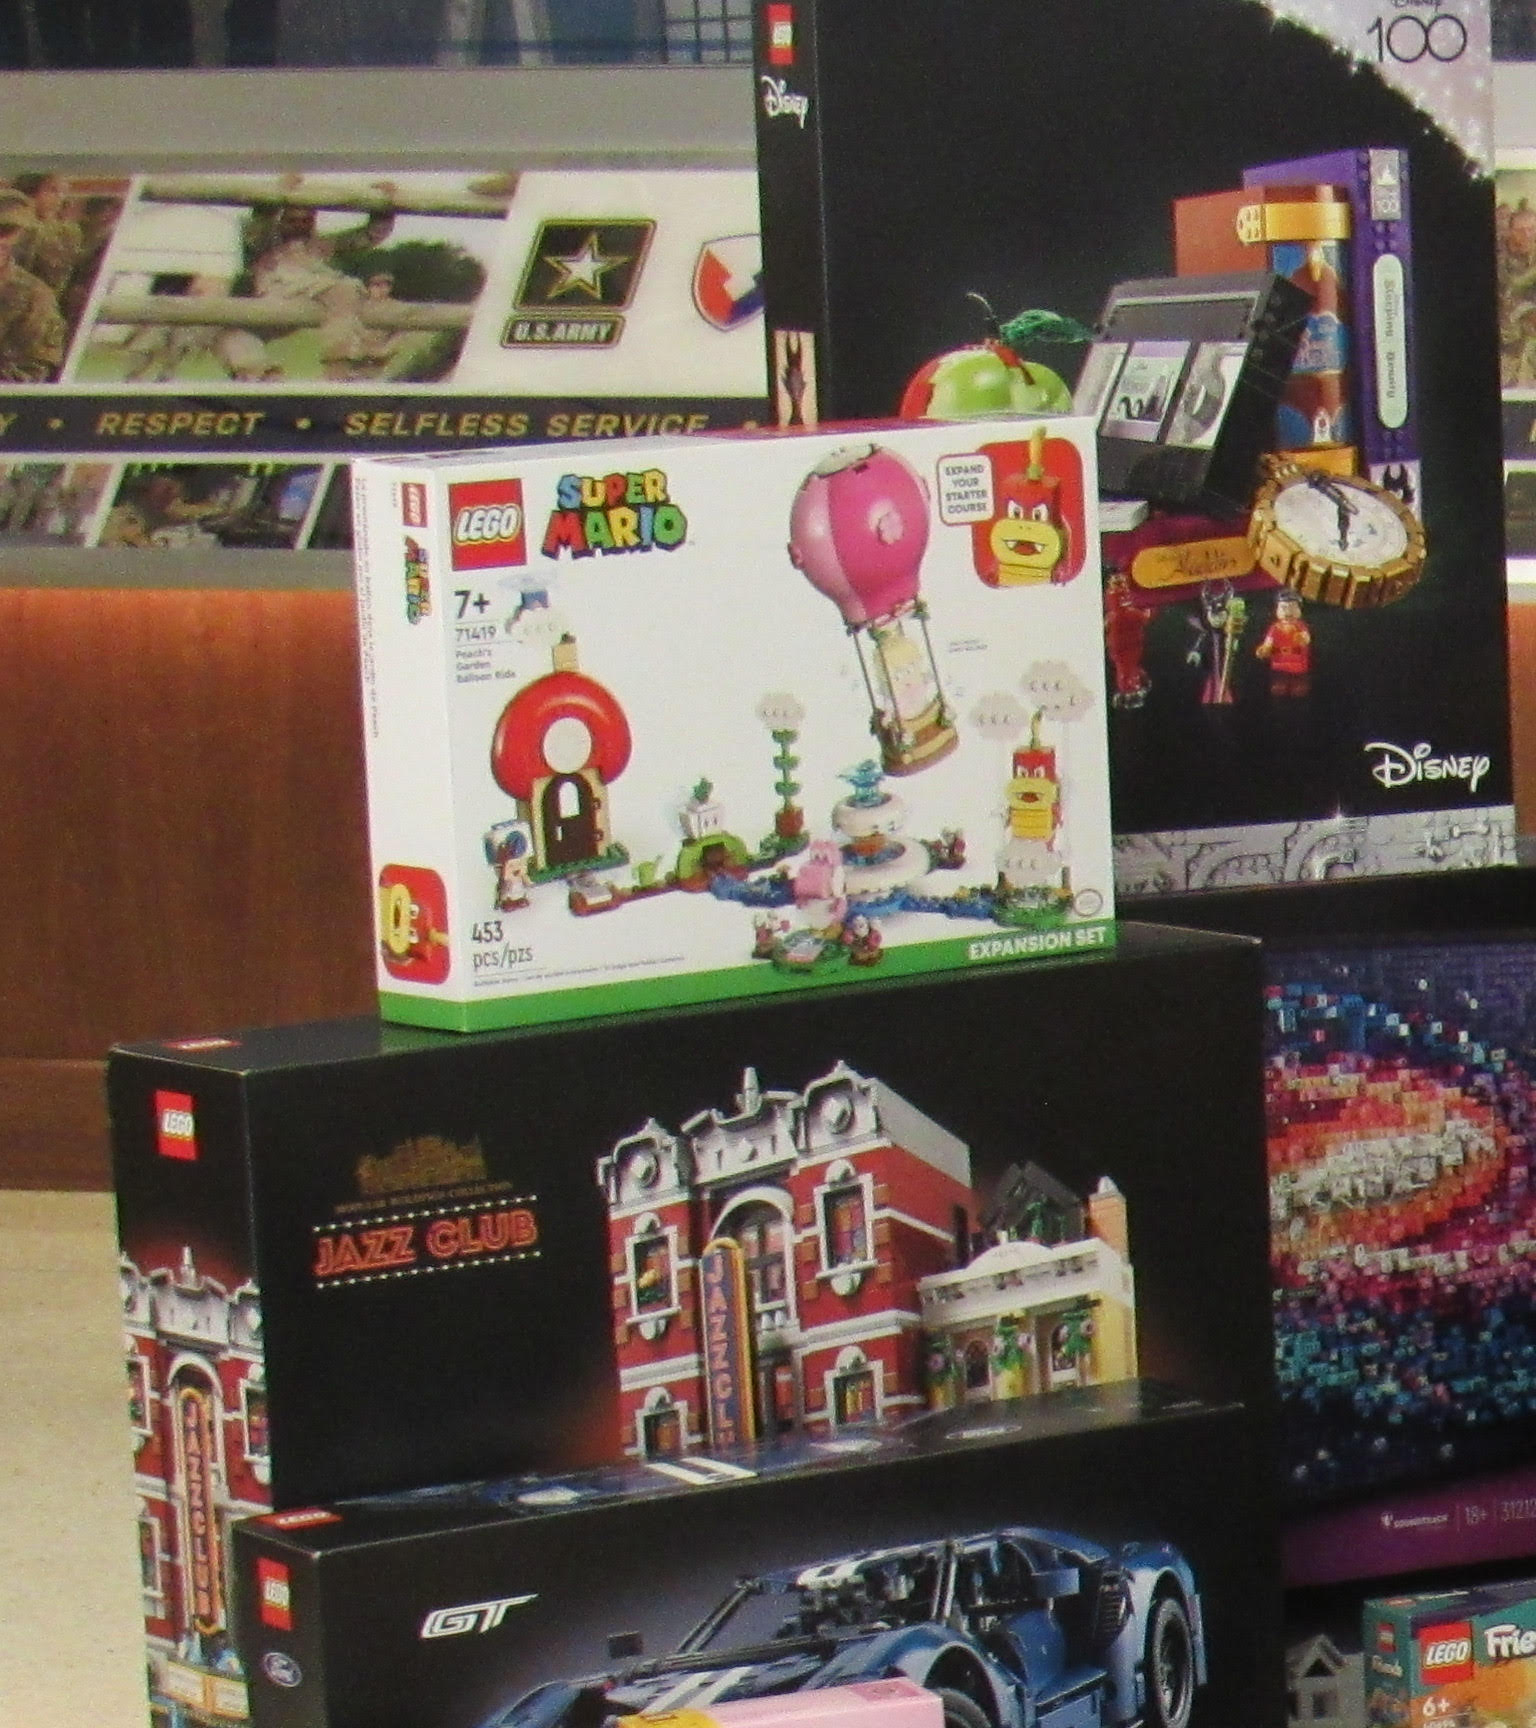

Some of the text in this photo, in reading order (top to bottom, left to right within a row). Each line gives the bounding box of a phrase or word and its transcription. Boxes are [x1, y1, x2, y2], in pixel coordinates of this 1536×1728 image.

[1367, 15, 1466, 63] 100
[762, 74, 809, 129] Disney
[558, 321, 613, 342] ARMY
[97, 413, 262, 437] RESPECT
[345, 413, 708, 437] SELFLESS SERVICE
[946, 464, 984, 478] EXPAND
[951, 478, 979, 489] YOUR
[555, 470, 668, 512] SUPER
[946, 489, 987, 501] STARTER
[455, 503, 520, 543] LEGO
[948, 502, 987, 514] COURSE
[541, 508, 686, 560] MARIO
[453, 589, 489, 620] 7+
[455, 627, 497, 644] 71419
[1364, 742, 1490, 791] Disney
[471, 919, 504, 943] 453
[968, 928, 1107, 962] EXPANSION SET
[472, 942, 534, 972] pcs/pzs
[161, 1108, 195, 1136] LEGO
[316, 1208, 539, 1277] JAZZ CLUB
[263, 1583, 289, 1607] LEGO
[420, 1594, 539, 1639] GT
[1426, 1636, 1469, 1667] LEGO
